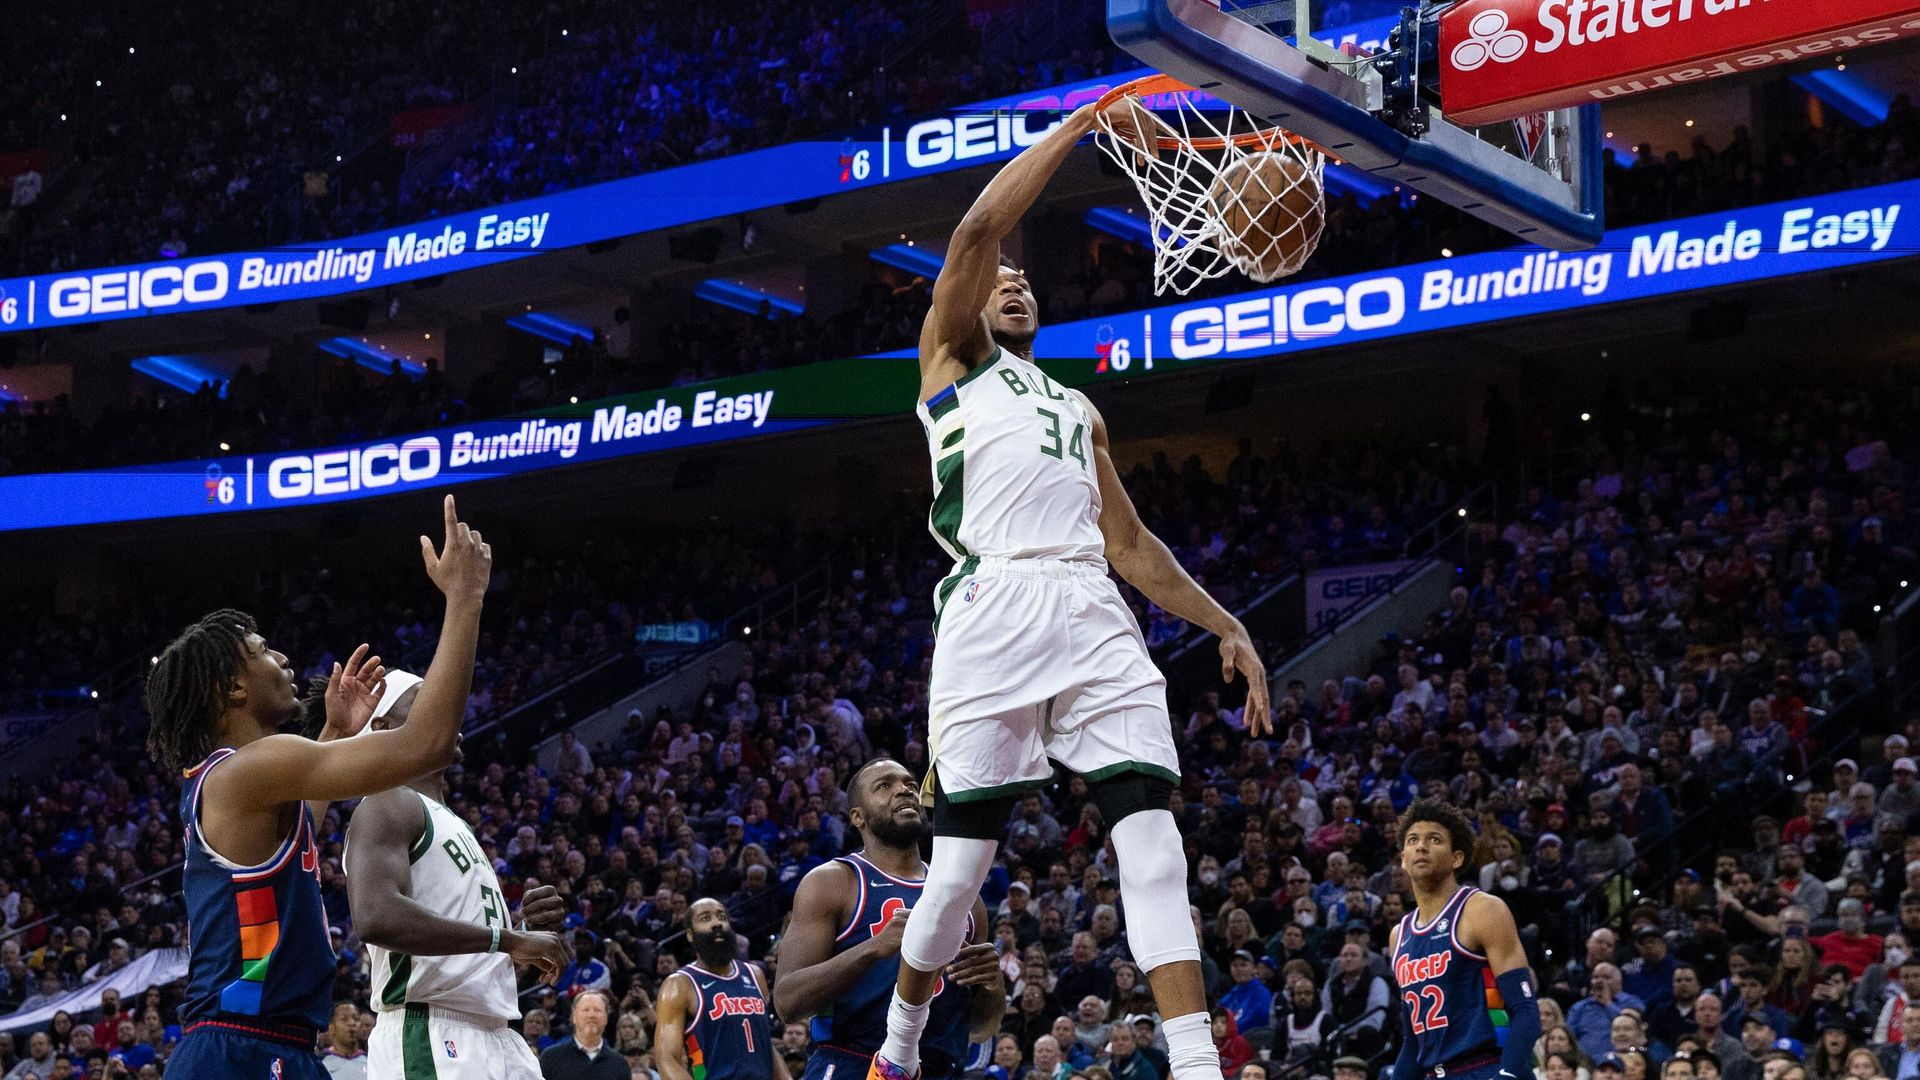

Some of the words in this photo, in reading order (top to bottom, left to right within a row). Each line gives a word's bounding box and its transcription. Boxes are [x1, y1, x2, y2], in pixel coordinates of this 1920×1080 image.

[906, 86, 1110, 168] GEIC
[0, 297, 18, 323] 6
[48, 261, 229, 318] GEICO
[239, 247, 376, 291] Bundling
[383, 226, 467, 270] Made
[475, 212, 550, 252] Easy
[1094, 338, 1131, 373] 76
[1170, 278, 1406, 360] GEICO
[1419, 250, 1612, 312] Bundling
[1627, 222, 1761, 277] Made
[1779, 205, 1901, 254] Easy
[204, 476, 235, 505] 76
[268, 437, 441, 499] GEICO
[449, 418, 581, 467] Bundling
[590, 399, 682, 444] Made
[692, 390, 774, 427] Easy
[1037, 406, 1087, 471] 34
[742, 1018, 755, 1053] 1
[1405, 985, 1449, 1035] 22
